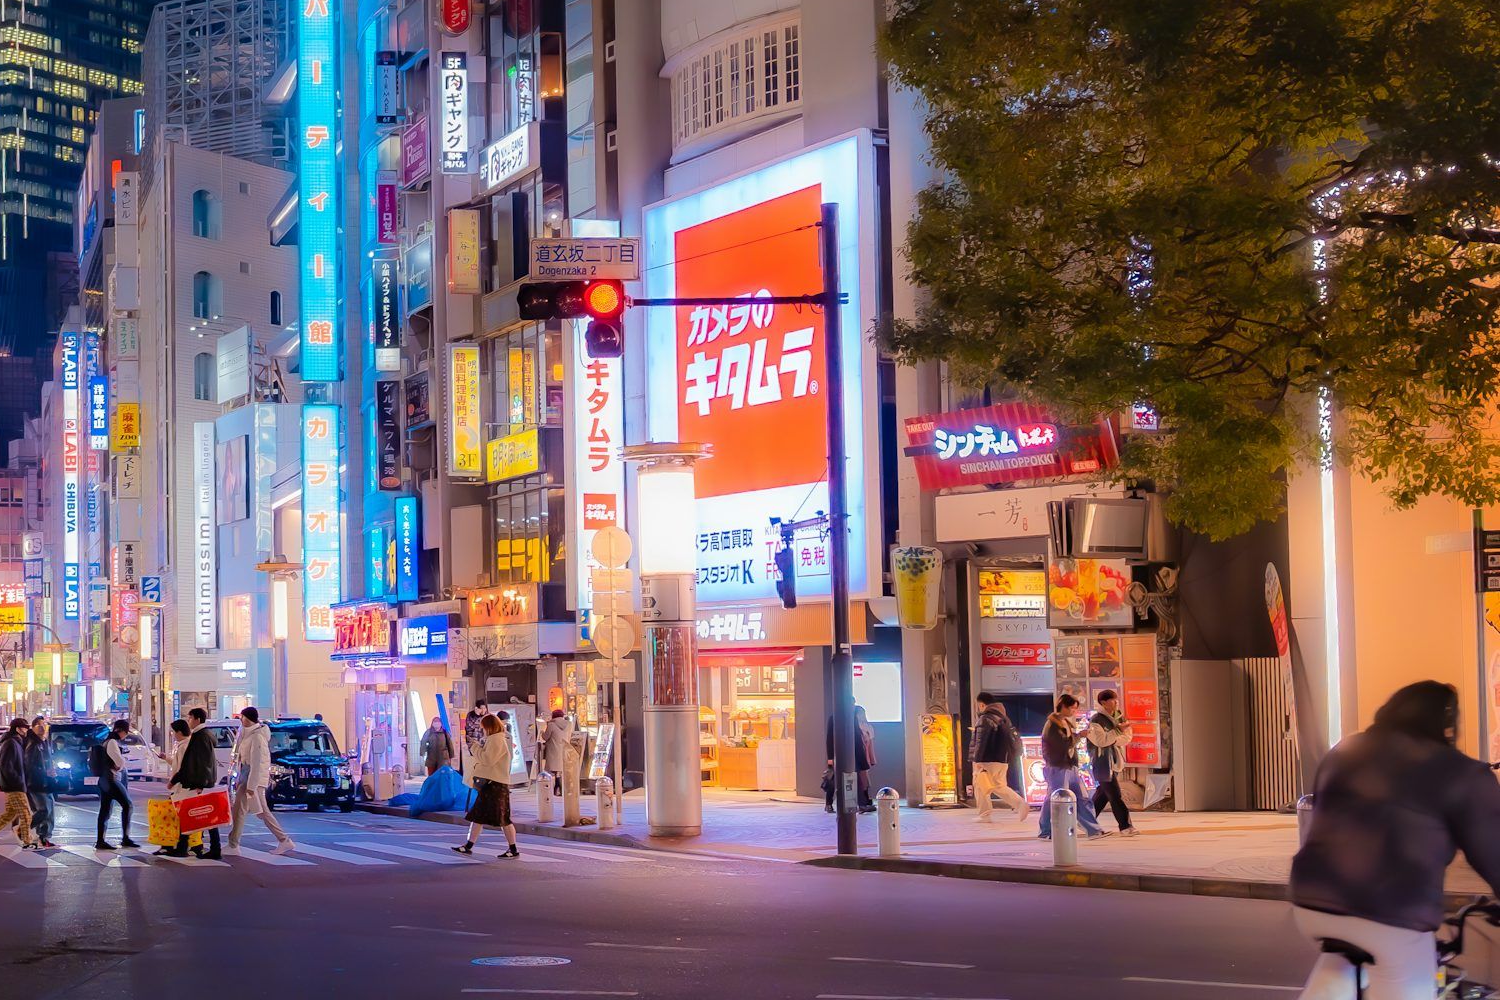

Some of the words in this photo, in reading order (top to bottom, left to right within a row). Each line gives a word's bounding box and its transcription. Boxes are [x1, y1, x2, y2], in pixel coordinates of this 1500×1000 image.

[447, 58, 460, 69] 5F
[535, 244, 635, 264] 道玄坂二丁目
[538, 265, 587, 277] Dogenzaka
[590, 265, 597, 276] 2
[687, 288, 775, 348] カメラの
[64, 350, 77, 387] LABI
[685, 327, 815, 417] キタムラ
[93, 384, 105, 429] 洋服の青山
[455, 352, 467, 427] 韓国料理専門店
[122, 412, 134, 434] 麻雀
[906, 423, 920, 433] TAKE
[920, 422, 935, 431] OUT
[64, 432, 77, 472] LABI
[458, 453, 477, 467] 3F
[935, 424, 1019, 460] シンチャム
[122, 456, 134, 489] ストレッチ
[960, 461, 1005, 475] SINCHAM
[1005, 453, 1055, 468] TOPPOKKI
[66, 483, 76, 534] SHIBUYA
[306, 416, 332, 629] カラオケ館
[800, 545, 827, 567] 免税
[198, 515, 211, 635] intimissimi
[65, 580, 78, 617] LABI
